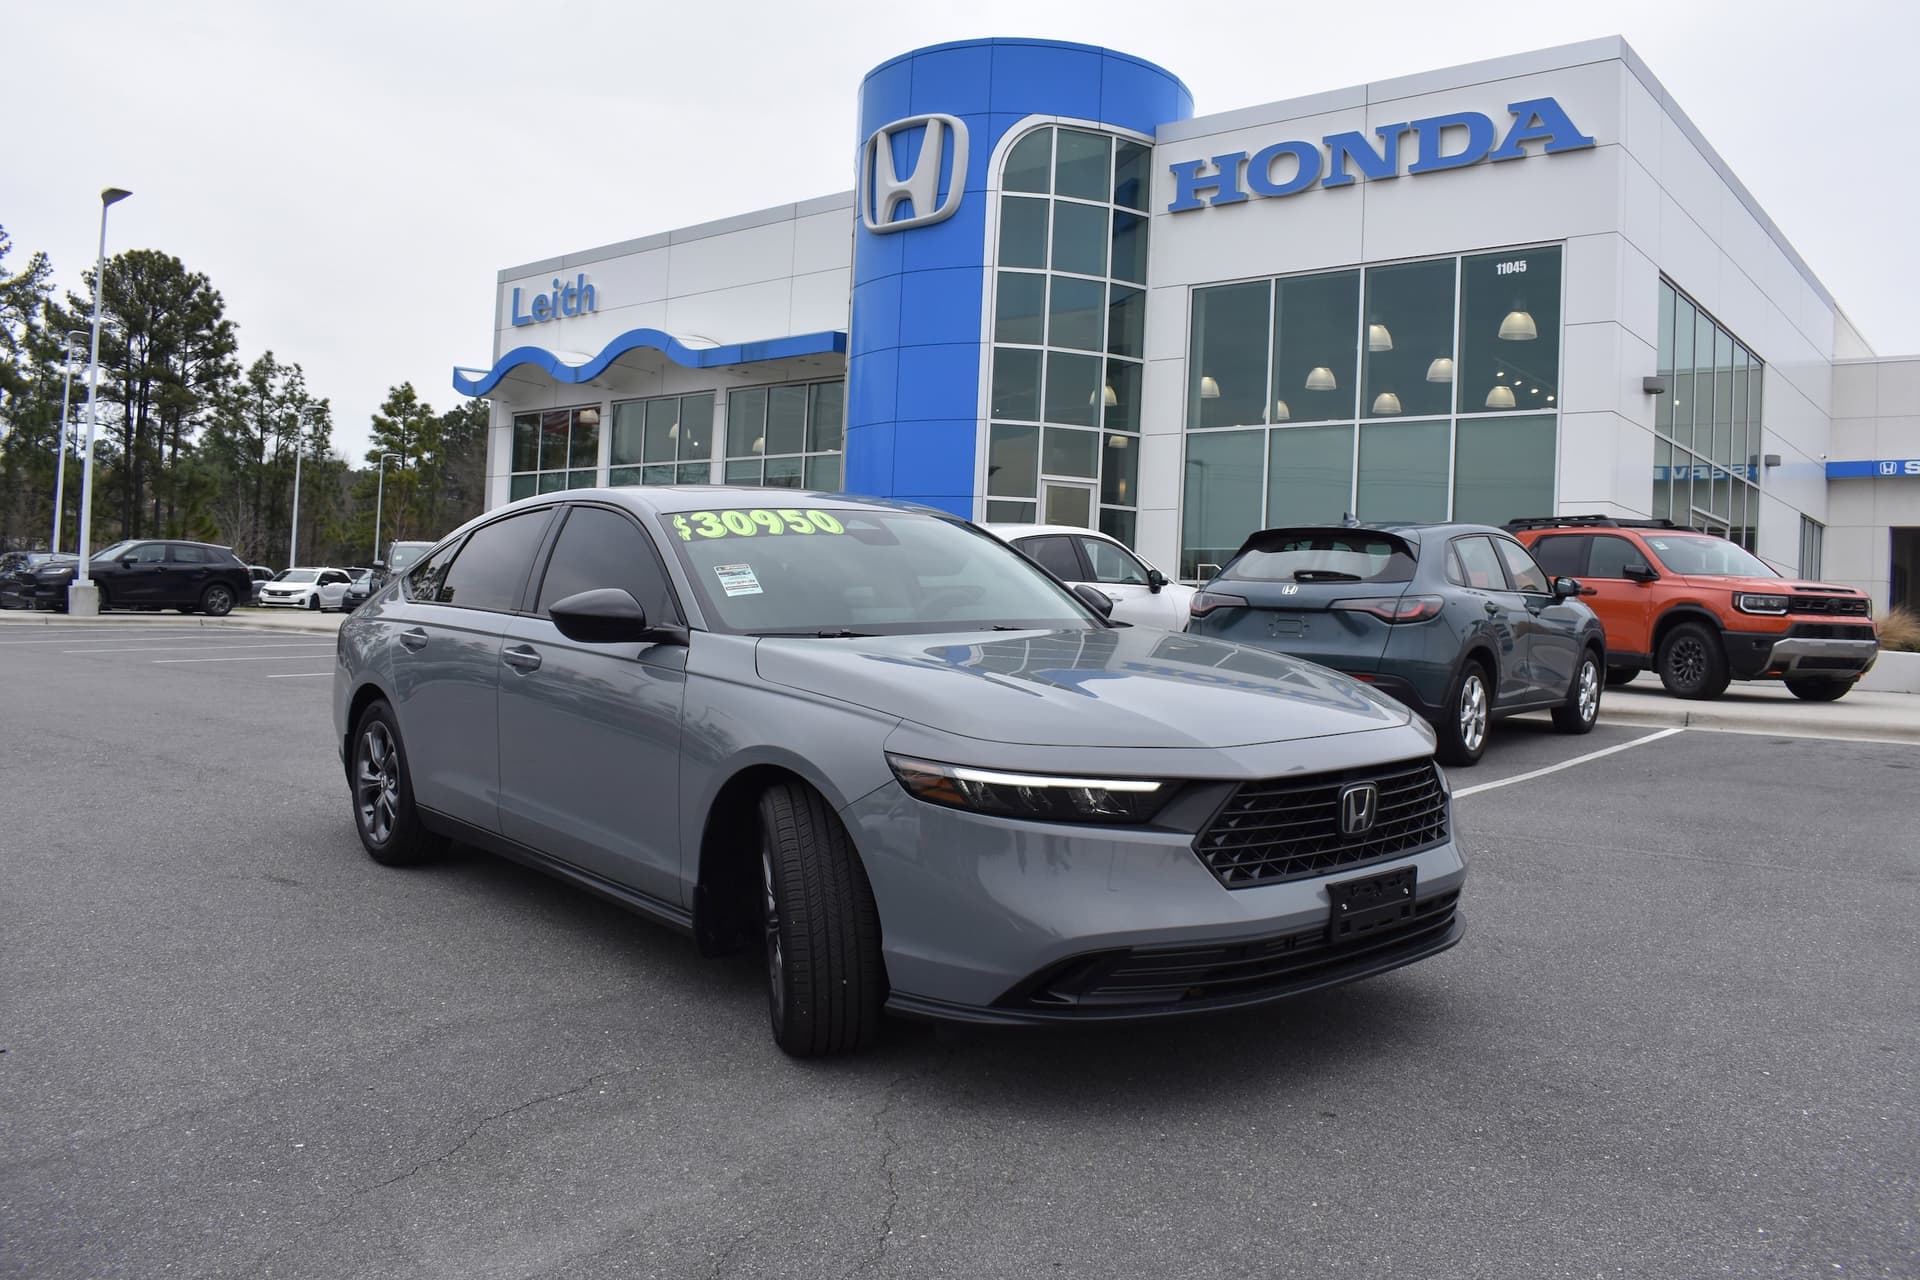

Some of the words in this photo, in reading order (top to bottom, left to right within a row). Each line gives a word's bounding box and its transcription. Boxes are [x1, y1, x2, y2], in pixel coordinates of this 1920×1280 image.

[1168, 96, 1595, 212] HONDA
[1496, 260, 1527, 275] 11045
[511, 273, 596, 326] Leith
[673, 509, 845, 541] $30950
